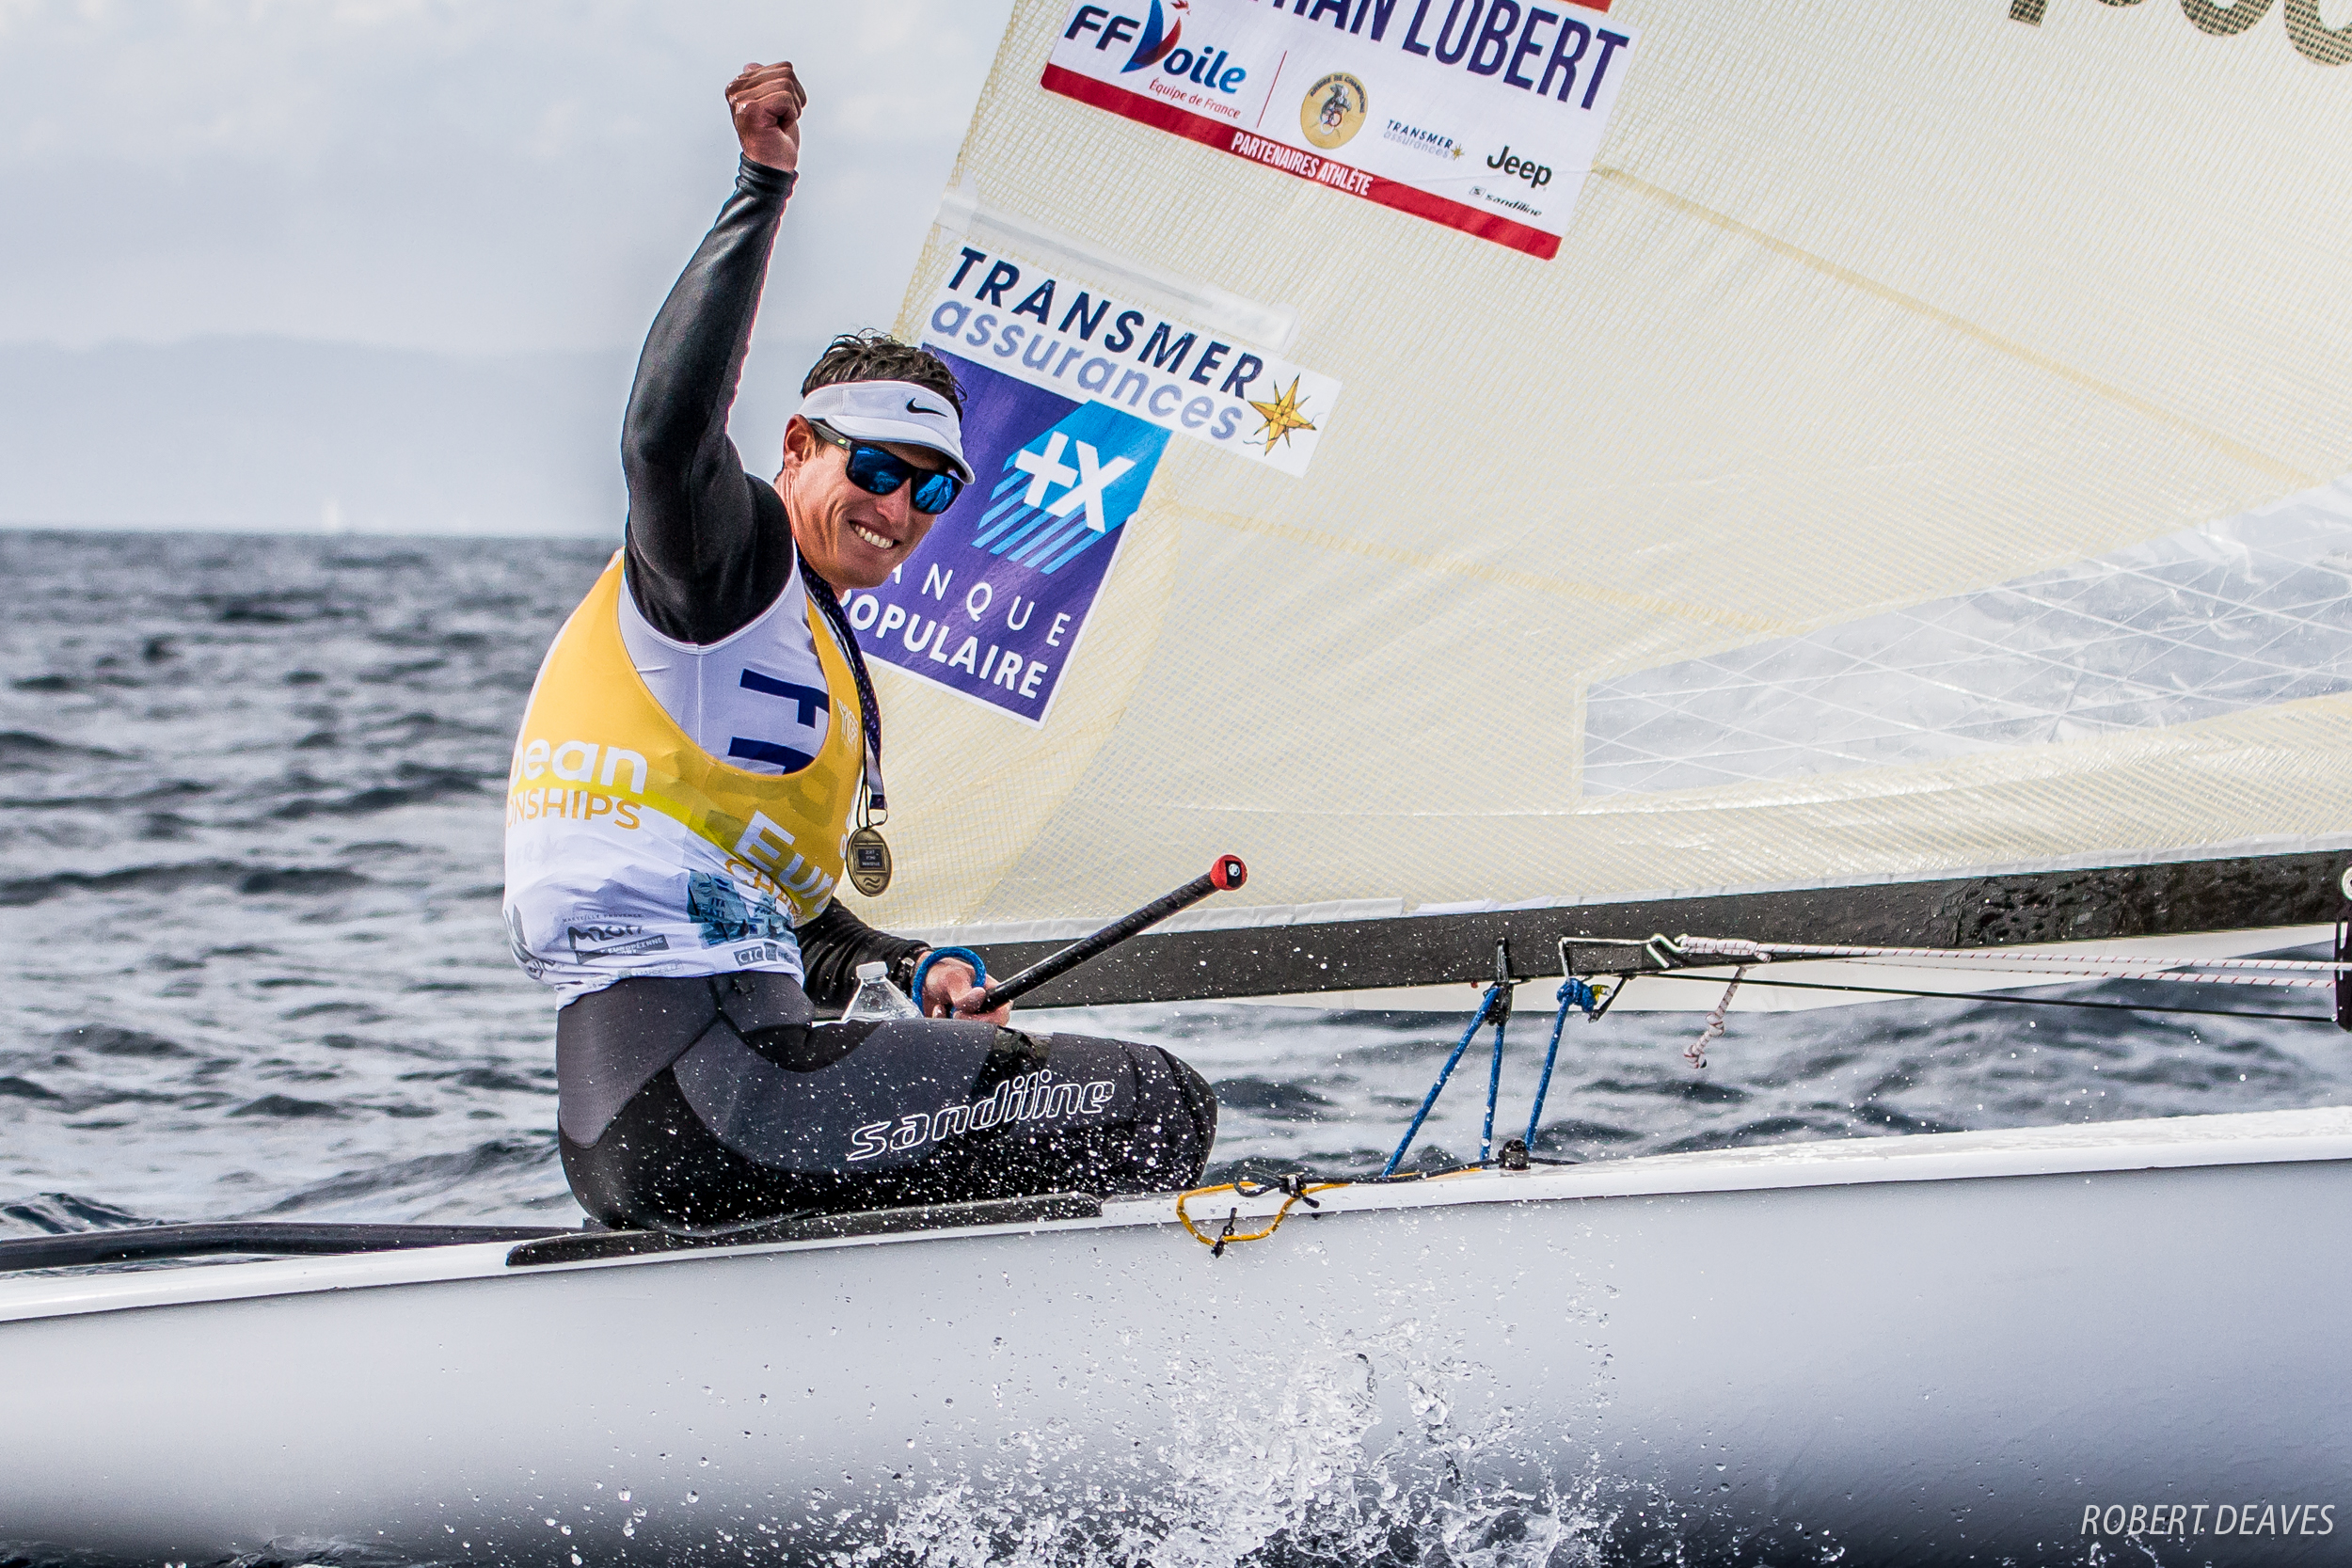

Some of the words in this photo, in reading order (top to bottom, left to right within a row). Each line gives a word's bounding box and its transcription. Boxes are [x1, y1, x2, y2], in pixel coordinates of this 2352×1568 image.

[1402, 0, 1629, 111] LOBERT
[1149, 76, 1187, 102] Équipe
[1188, 91, 1202, 106] de
[1204, 98, 1241, 119] France
[1231, 131, 1320, 178] PARTENAIRES
[1383, 130, 1451, 160] assurances
[1386, 119, 1454, 150] TRANSMER
[1486, 145, 1552, 188] Jeep
[946, 246, 1264, 401] TRANSMER
[930, 298, 1245, 440] assurances
[893, 562, 1071, 647] NQUE
[846, 1069, 1115, 1162] sandiline
